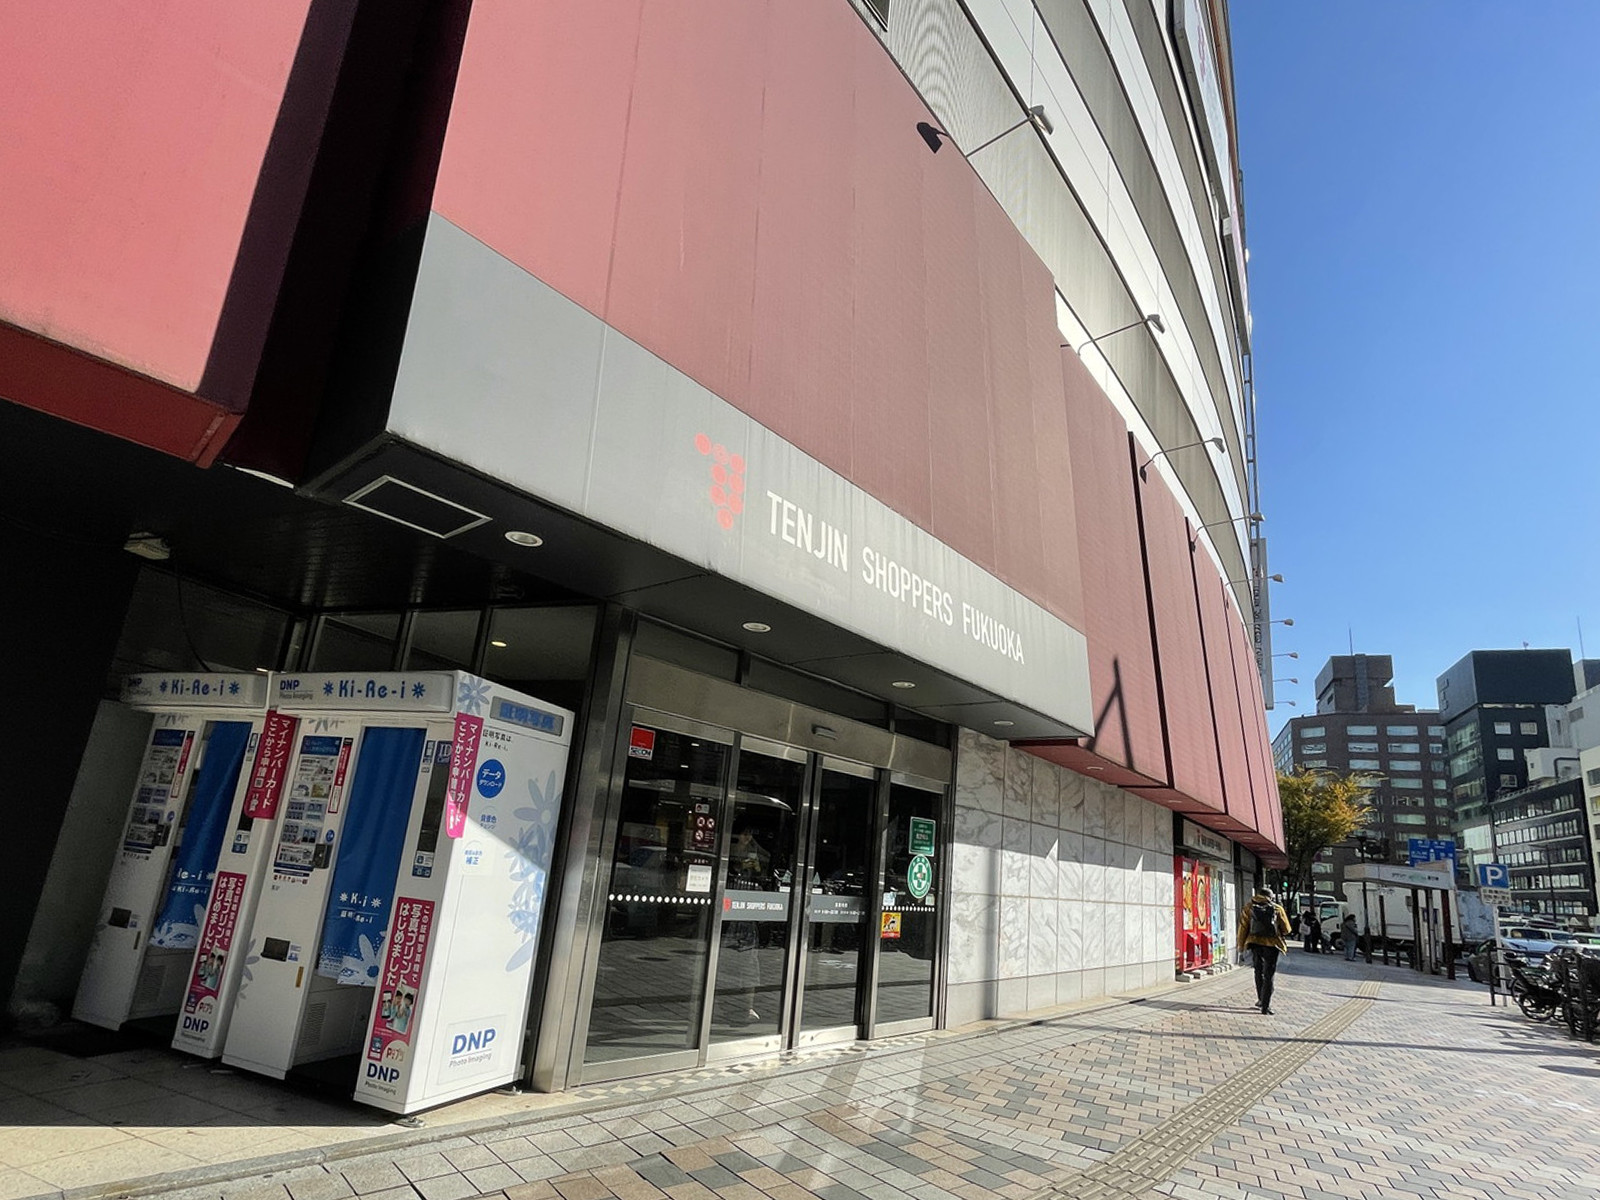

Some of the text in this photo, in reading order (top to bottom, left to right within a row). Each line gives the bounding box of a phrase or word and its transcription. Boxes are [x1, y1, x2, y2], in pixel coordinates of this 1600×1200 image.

[767, 490, 1025, 665] TENJIN SHOPPERS FUKUOKA
[171, 679, 224, 696] Ki-Re-i
[279, 680, 300, 690] DNP
[338, 679, 406, 699] Ki-Re-i
[262, 719, 292, 809] マイナンバーカード
[455, 723, 478, 825] マイナンバーカード
[482, 768, 501, 780] データ
[1485, 866, 1503, 886] P
[202, 877, 228, 950] はじめました
[213, 877, 237, 949] 写真プリント
[385, 902, 410, 987] はじめました
[400, 903, 422, 985] 写真プリント
[183, 1016, 209, 1033] DNP
[452, 1028, 496, 1055] DNP
[366, 1062, 400, 1083] DNP
